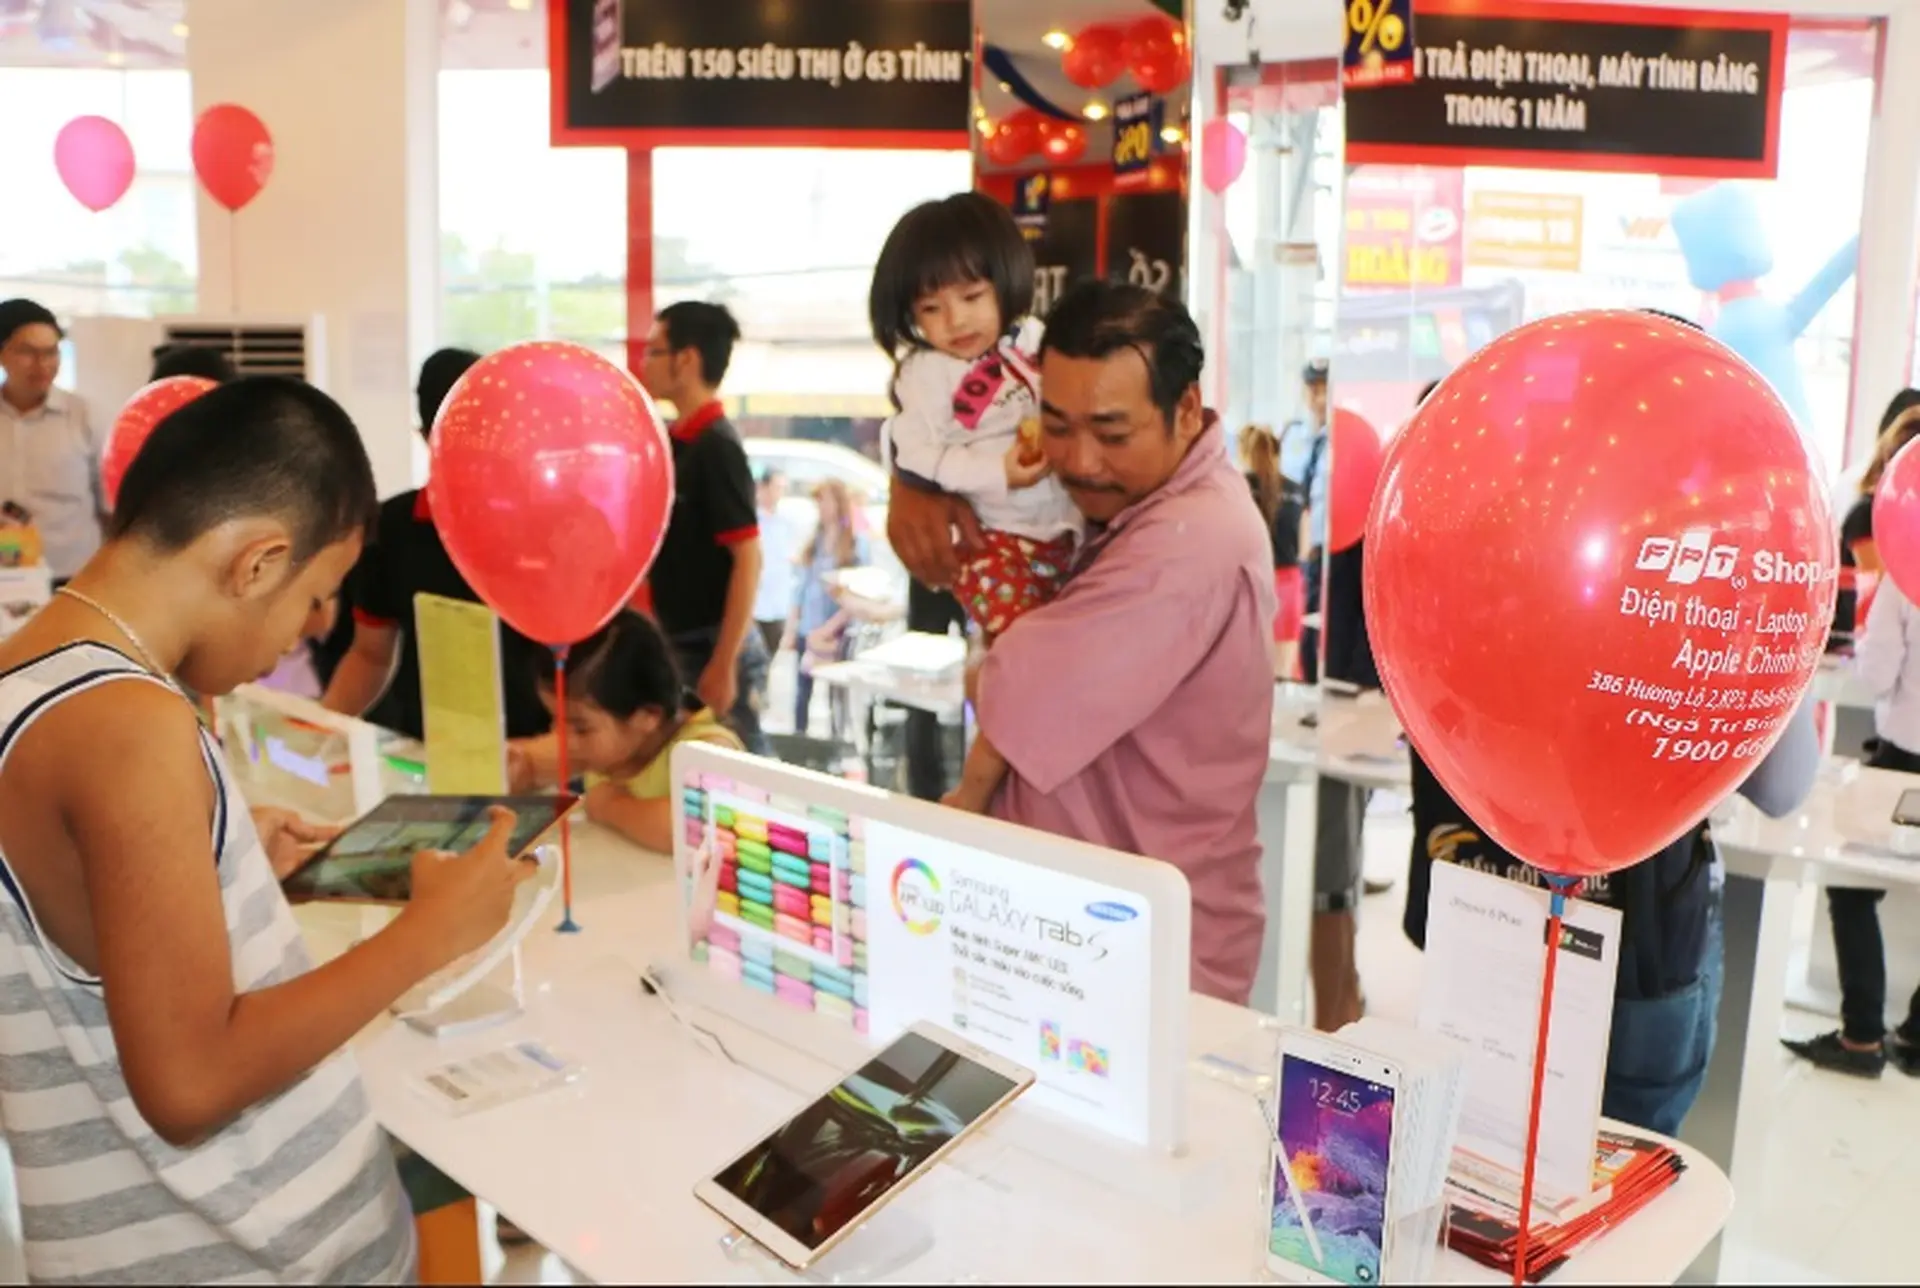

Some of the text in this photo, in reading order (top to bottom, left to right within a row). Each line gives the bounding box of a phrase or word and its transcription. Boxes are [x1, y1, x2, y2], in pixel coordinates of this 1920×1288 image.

[620, 42, 686, 79] TRÊN
[688, 48, 735, 79] 150
[737, 42, 795, 79] SIÊU
[797, 47, 841, 88] THỊ
[844, 40, 865, 80] Ở
[865, 50, 897, 82] 63
[1425, 40, 1466, 79] TRẢ
[1470, 45, 1522, 89] ĐIỆN
[1525, 51, 1596, 92] THOẠI,
[1598, 50, 1644, 88] MÁY
[1647, 52, 1697, 91] TÍNH
[1700, 52, 1759, 95] BẢNG
[1444, 93, 1586, 131] TRONG 1 NĂM
[1636, 530, 1740, 584] FPT
[1620, 586, 1677, 628] Điện
[1685, 596, 1740, 637] thoại
[1755, 605, 1807, 641] Laptop
[1672, 639, 1741, 680] Apple
[1586, 669, 1624, 694] 386
[1625, 677, 1684, 710] Hương
[1684, 685, 1706, 712] Lộ
[1710, 717, 1742, 734] Tư
[1652, 736, 1729, 762] 1900
[950, 889, 1029, 933] GALAXY
[1034, 916, 1083, 947] Tab
[1308, 1077, 1362, 1114] 12:45
